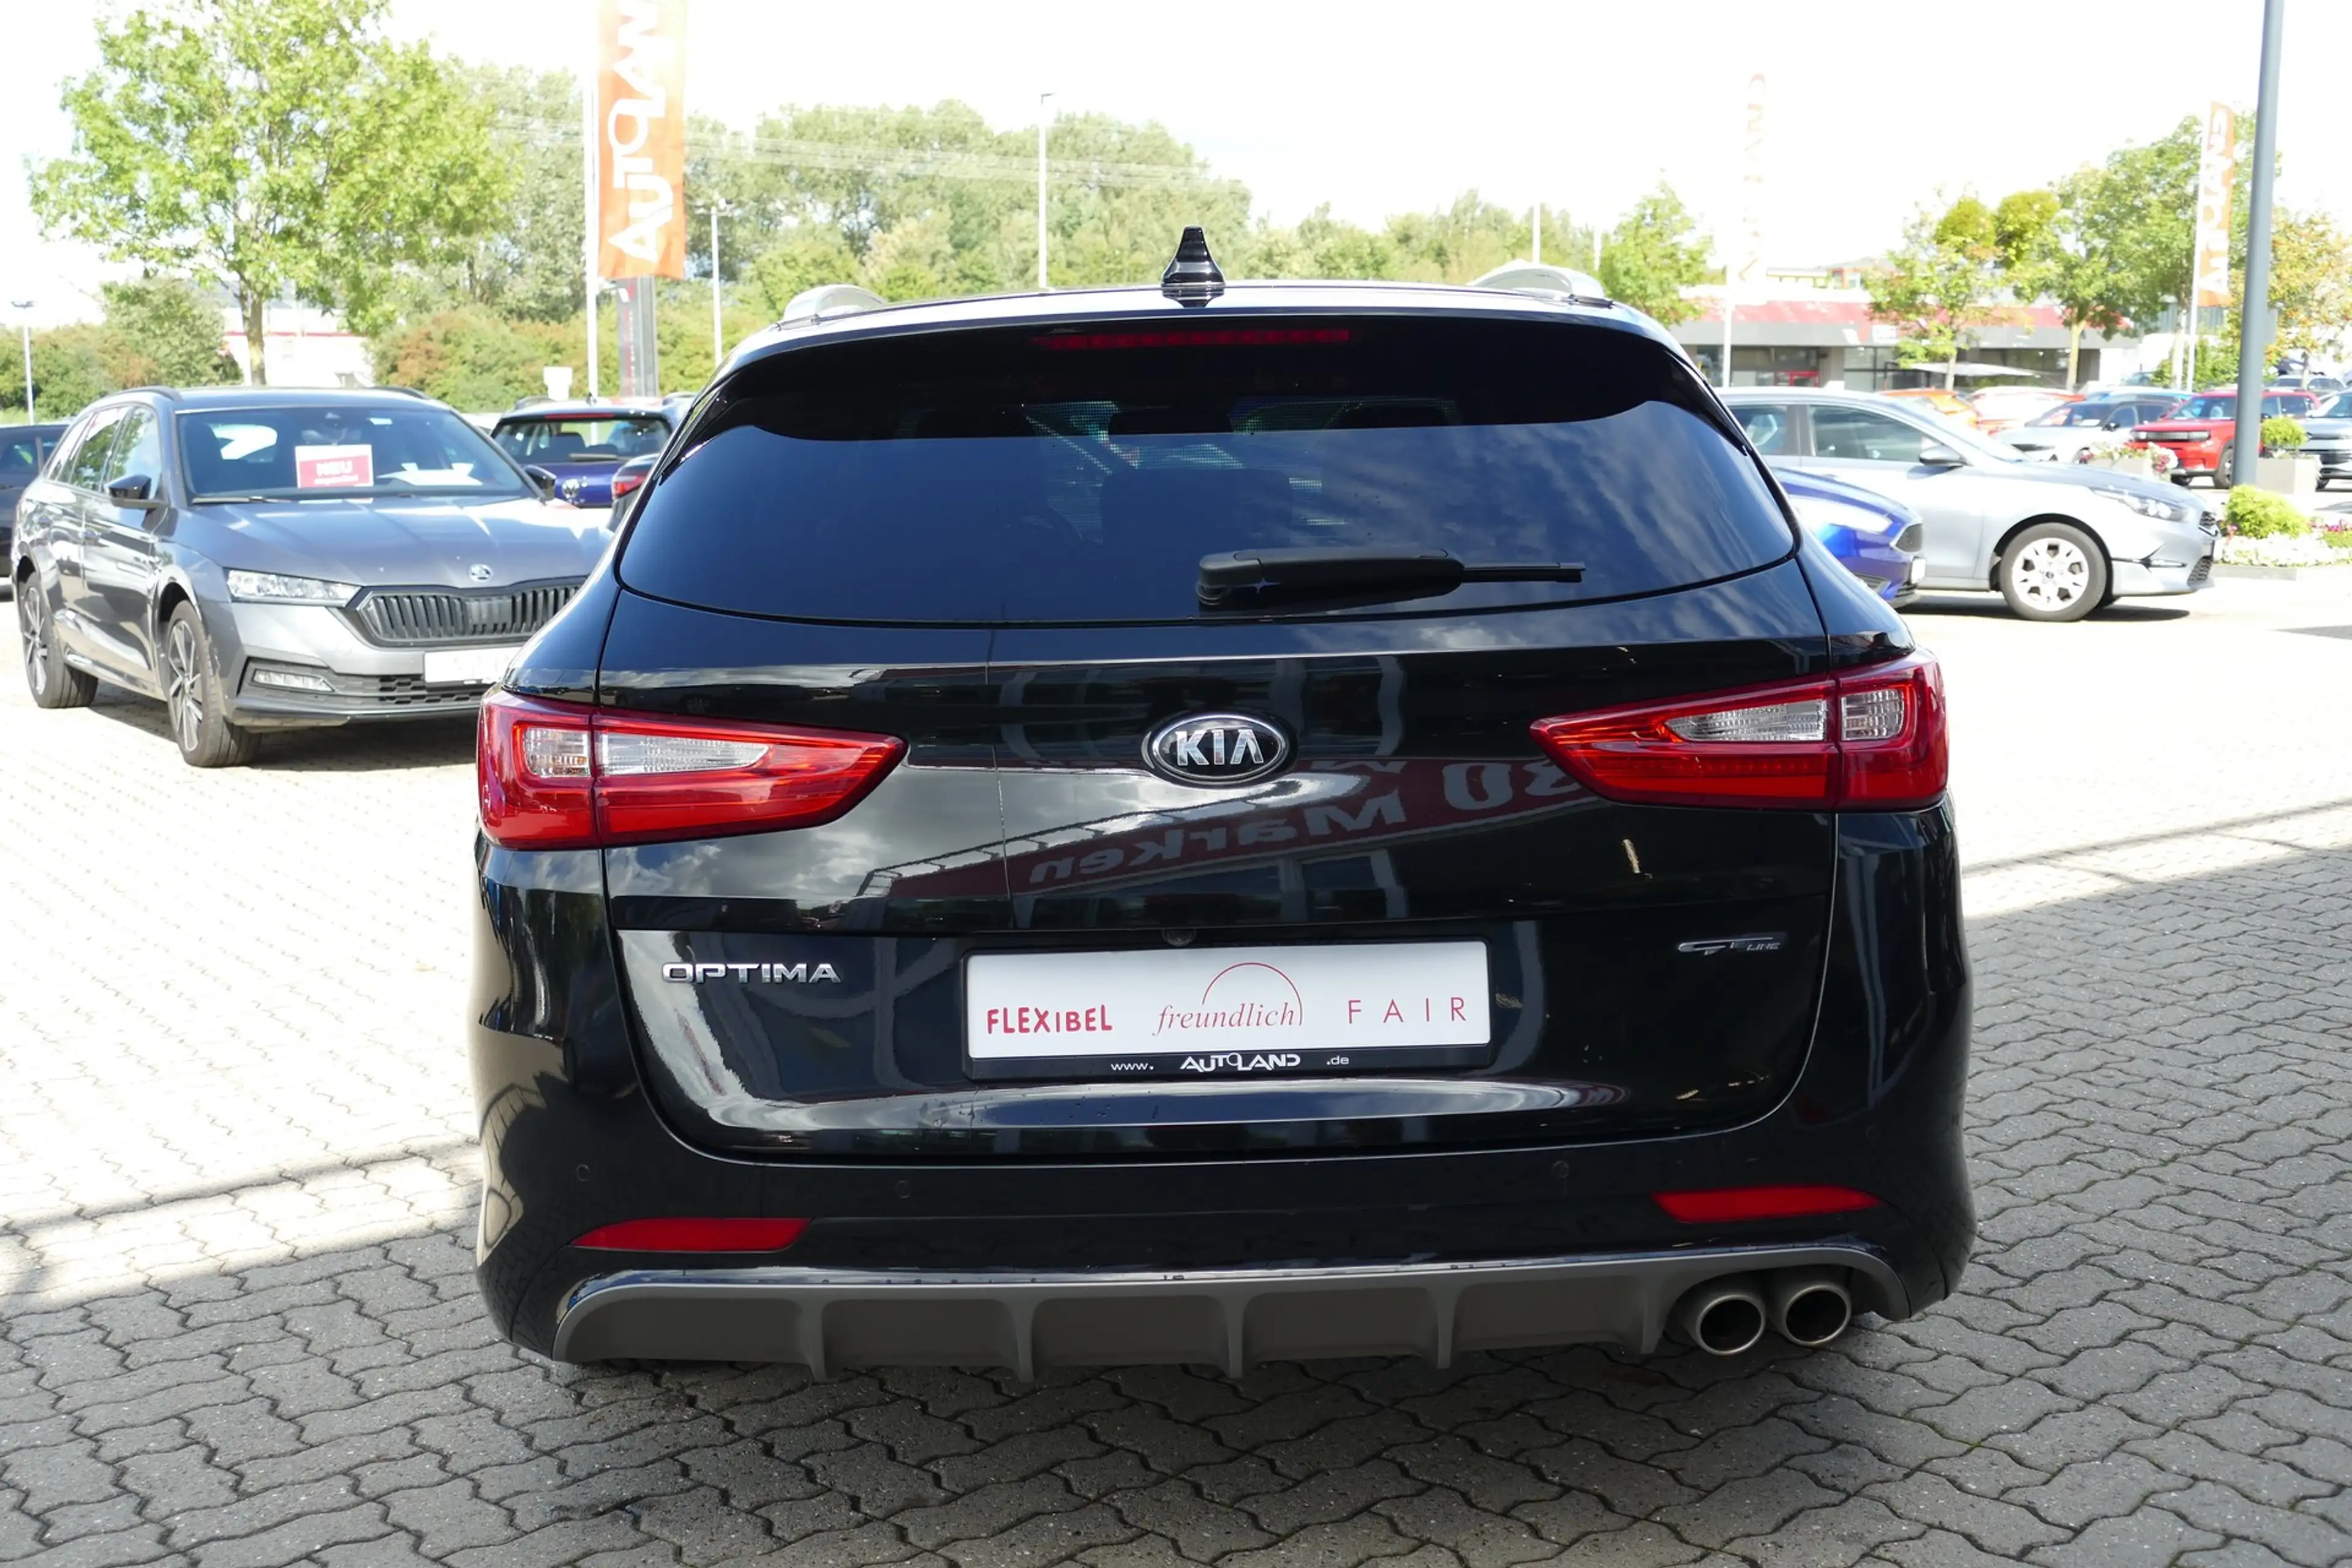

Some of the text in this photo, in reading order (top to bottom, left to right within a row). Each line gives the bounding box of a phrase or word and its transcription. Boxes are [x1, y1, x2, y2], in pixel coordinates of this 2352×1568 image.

[1176, 728, 1264, 766] KIA
[1746, 942, 1781, 951] LINE
[662, 963, 842, 983] OPTIMA
[987, 1005, 1113, 1035] FLEXIBEL
[1152, 1001, 1296, 1037] freundlich
[1111, 1062, 1155, 1071] www.
[1180, 1053, 1301, 1073] AUTOLAND
